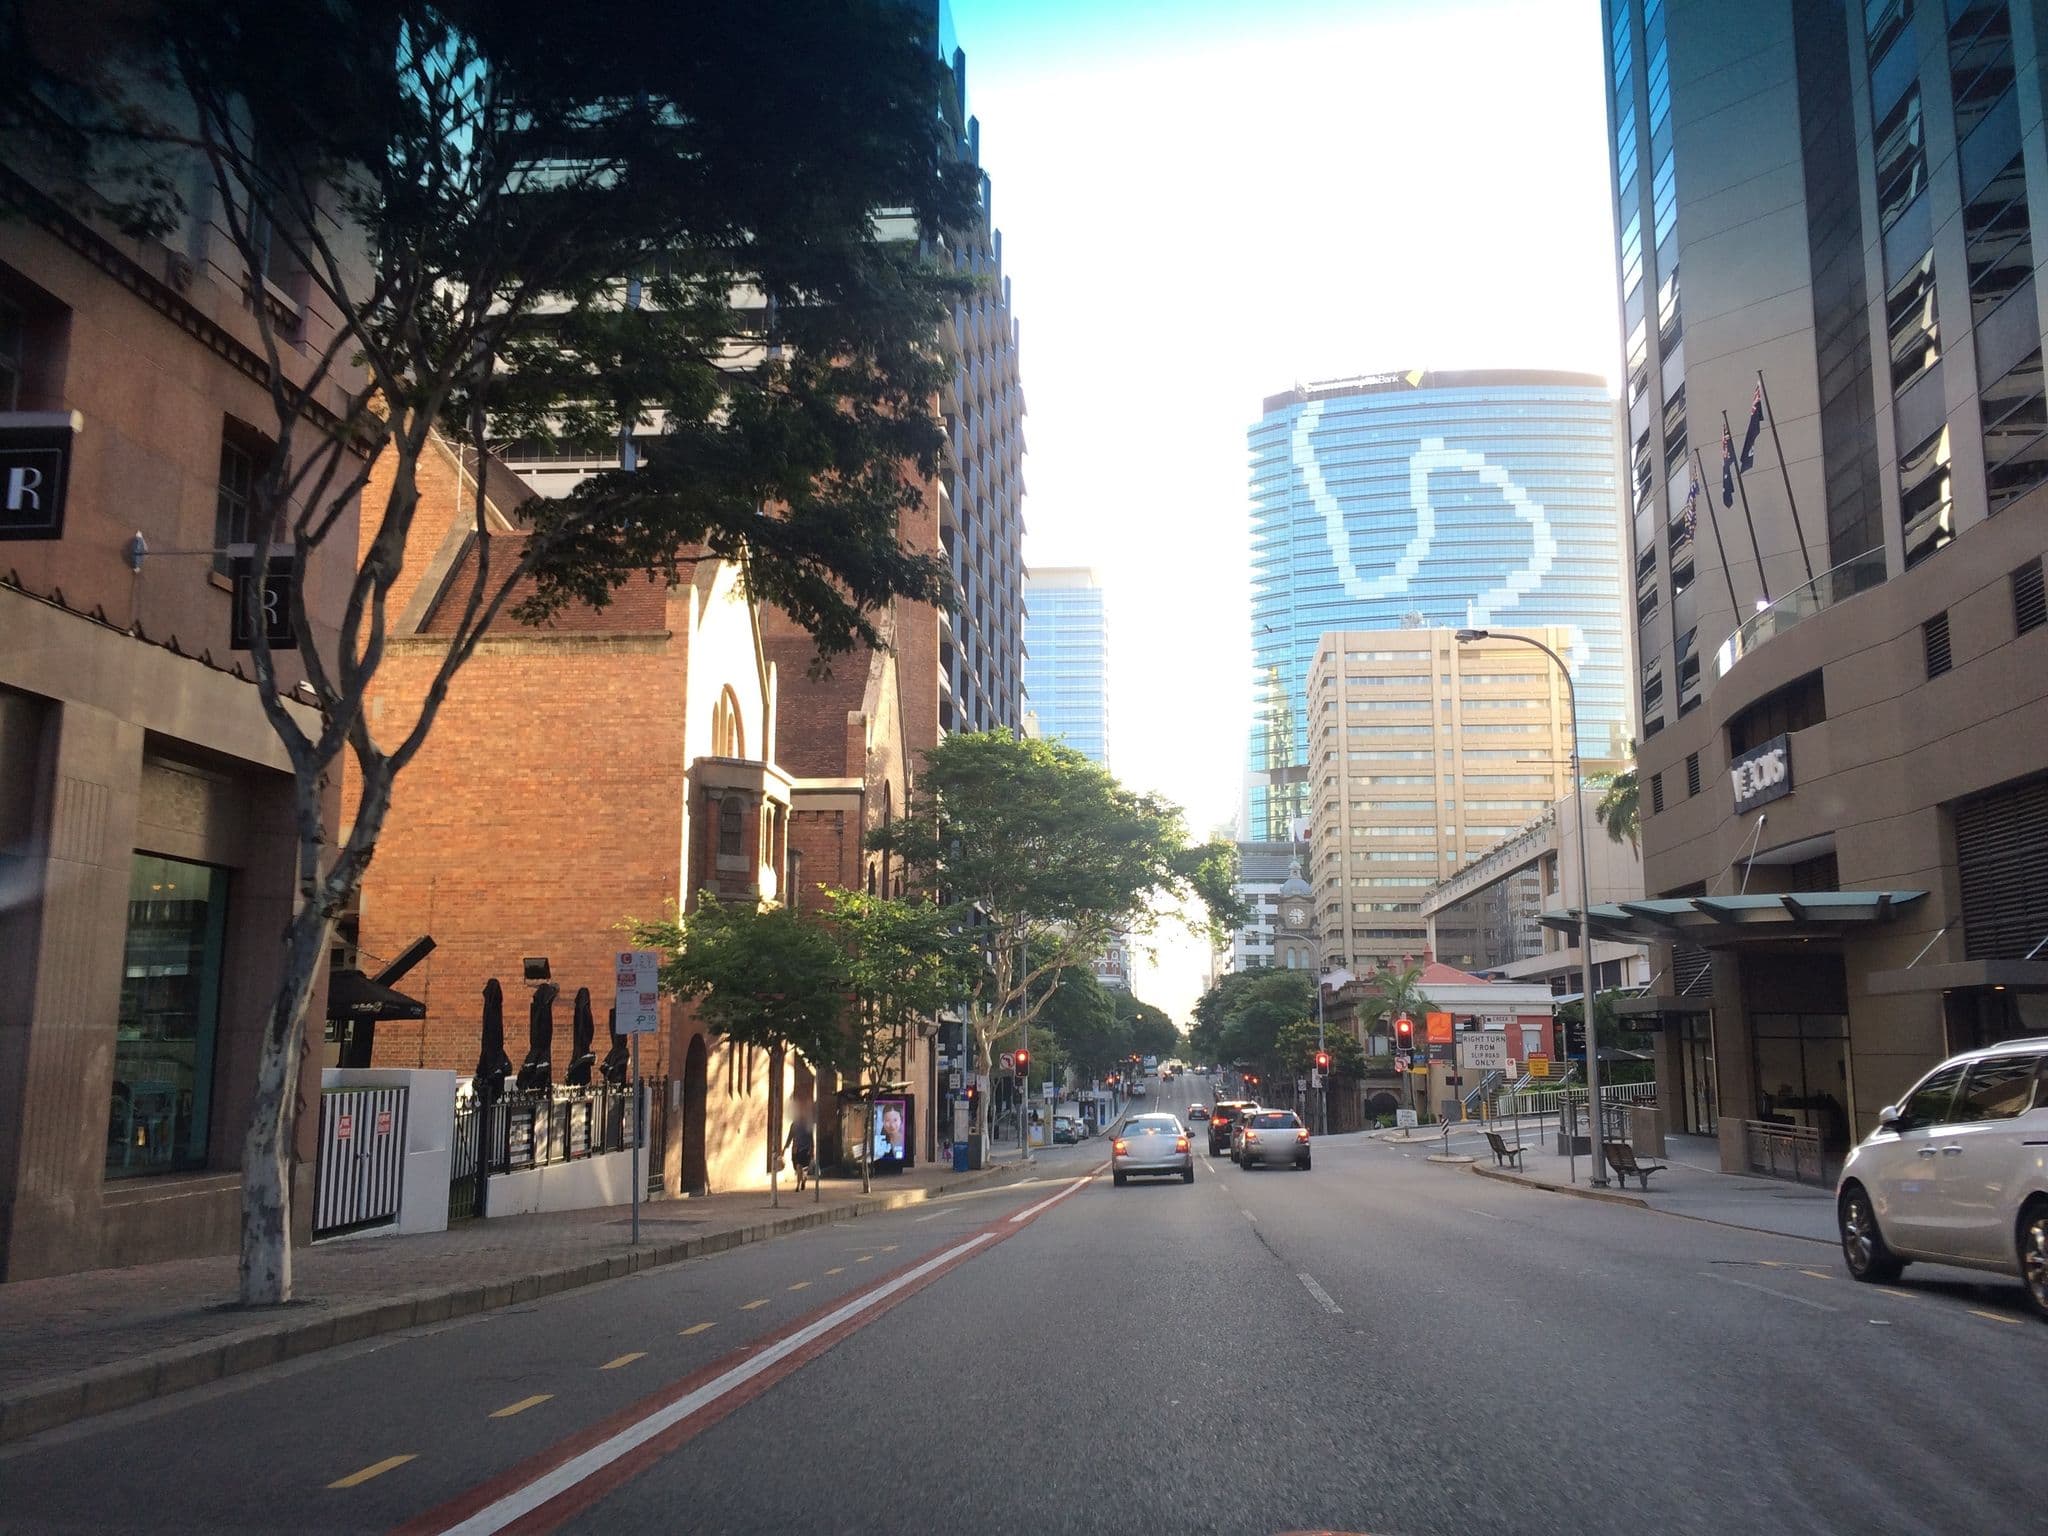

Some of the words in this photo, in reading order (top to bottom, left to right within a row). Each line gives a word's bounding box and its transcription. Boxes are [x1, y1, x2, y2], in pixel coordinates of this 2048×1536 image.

[6, 467, 43, 511] R
[1463, 1035, 1485, 1043] RIGHT
[1486, 1035, 1506, 1043] TURN
[1475, 1059, 1496, 1067] ONLY
